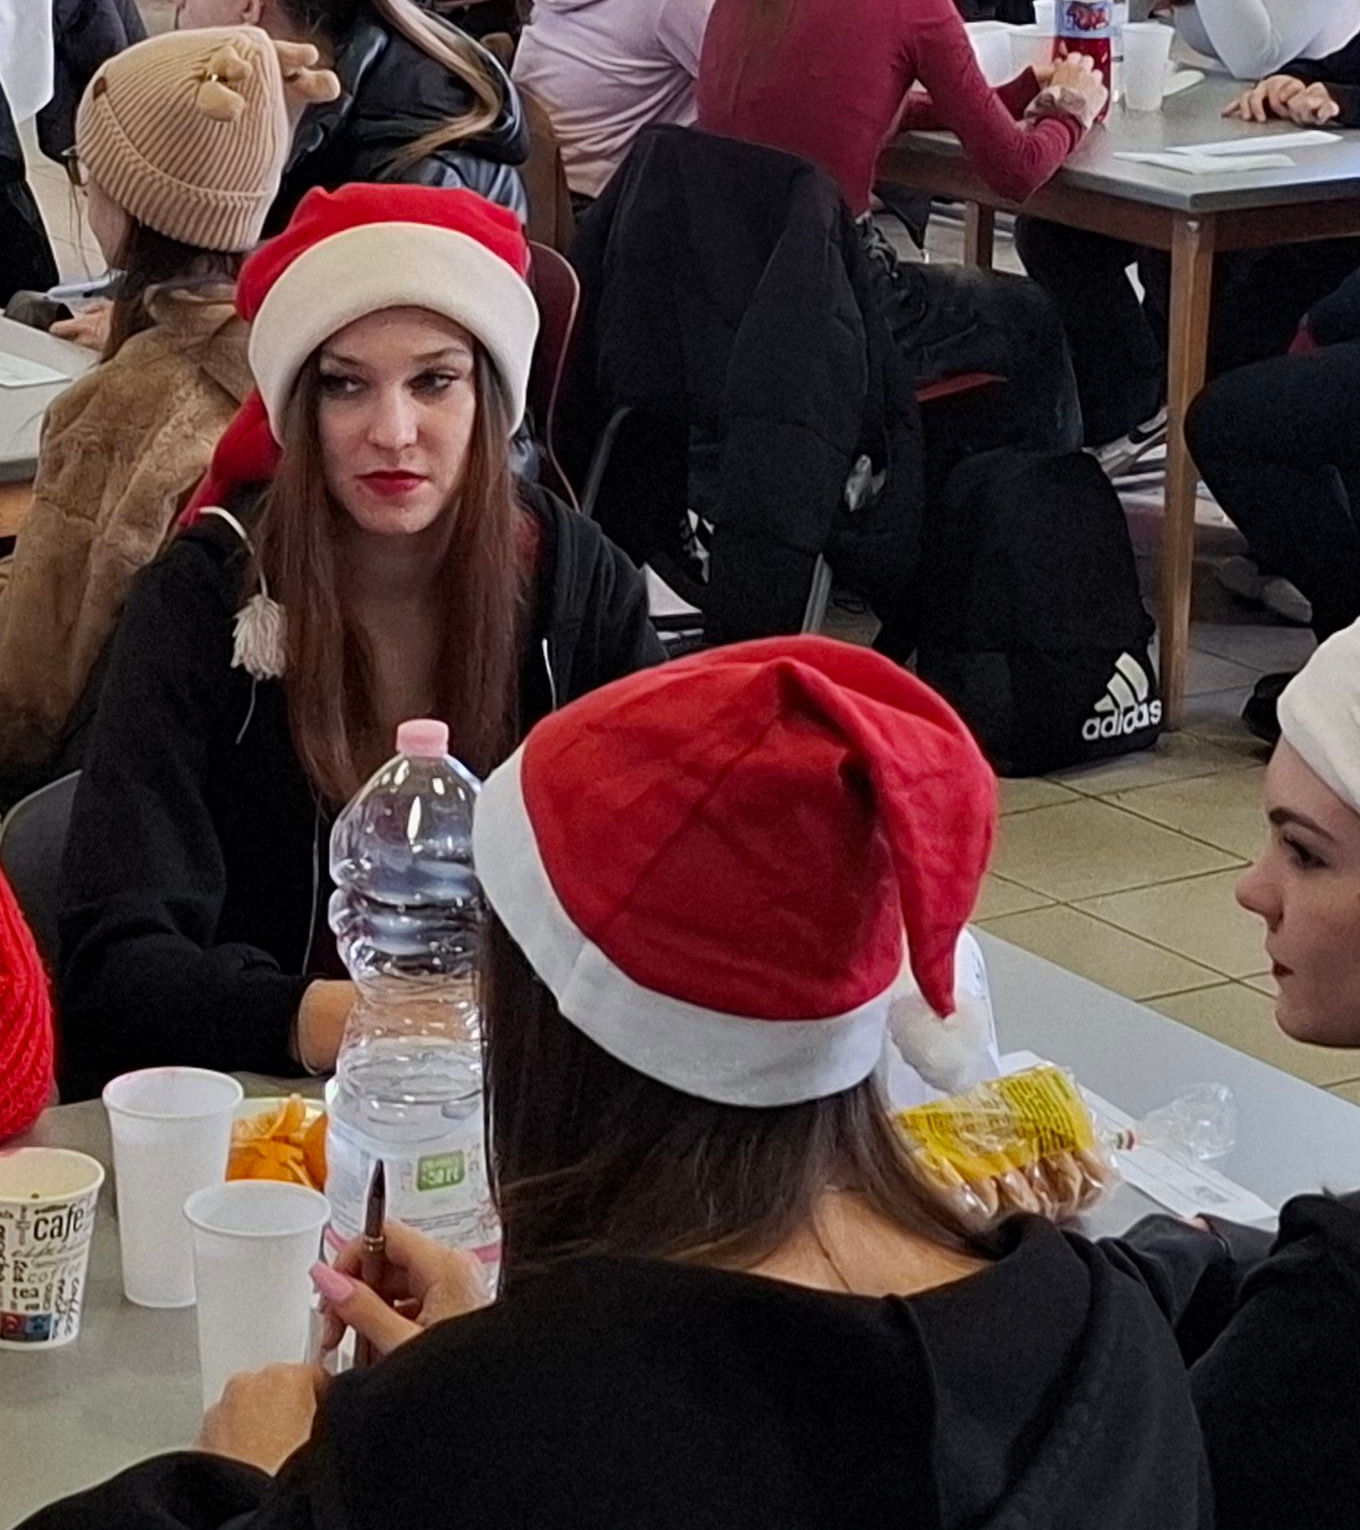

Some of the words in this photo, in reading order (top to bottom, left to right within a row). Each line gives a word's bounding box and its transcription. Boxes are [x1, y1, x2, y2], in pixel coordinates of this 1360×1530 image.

[1081, 699, 1162, 741] adidas
[33, 1203, 84, 1243] cafe
[12, 1286, 39, 1300] tea
